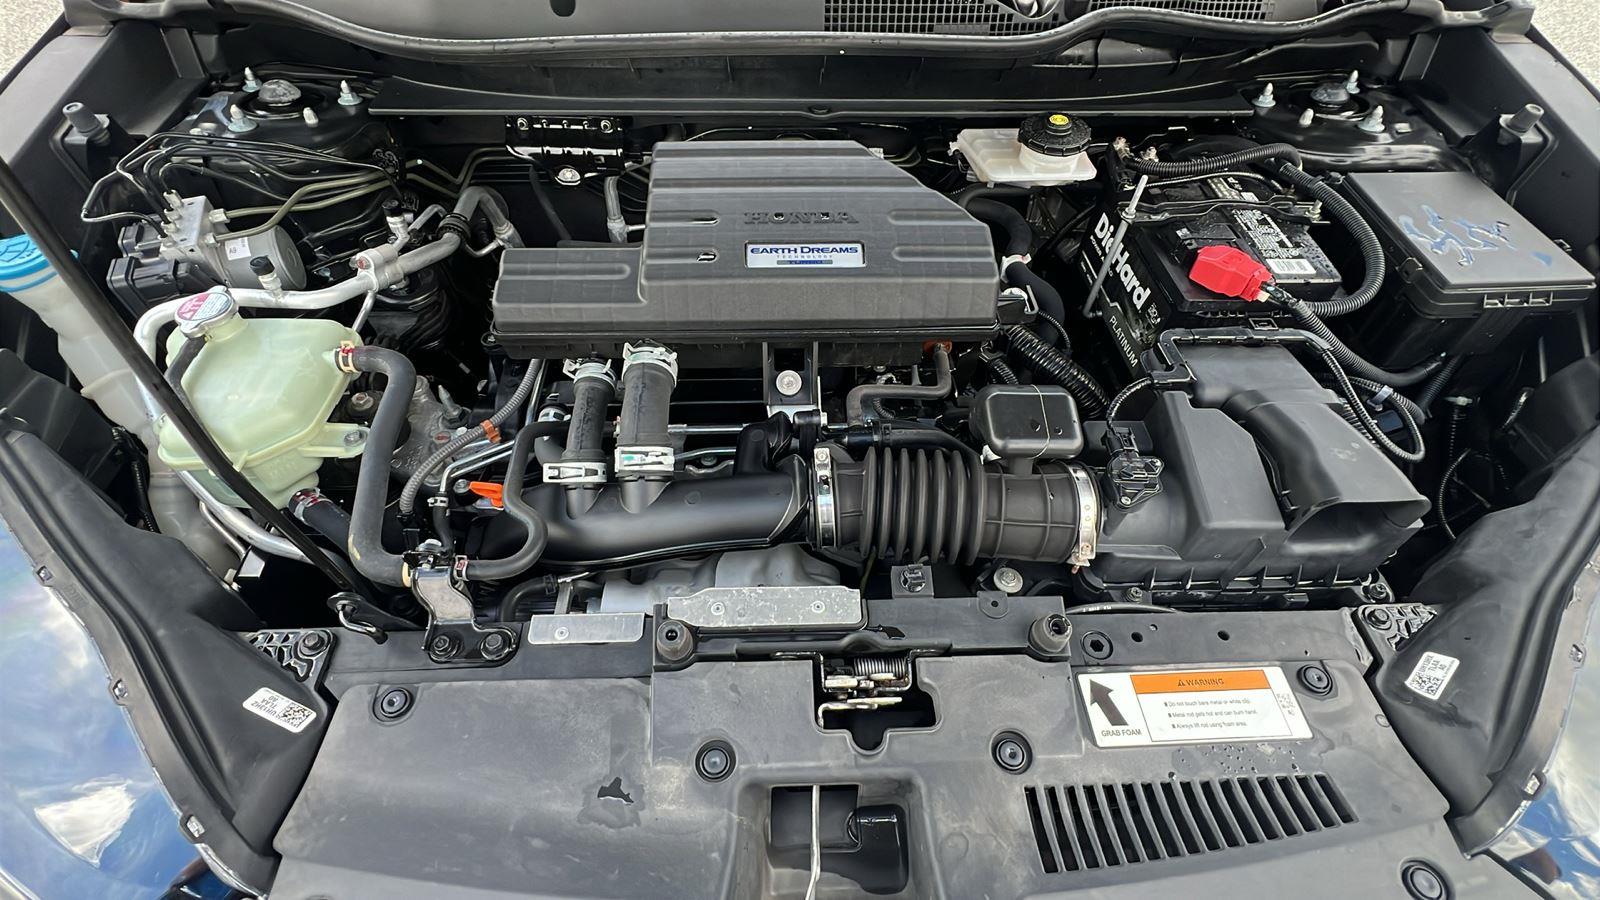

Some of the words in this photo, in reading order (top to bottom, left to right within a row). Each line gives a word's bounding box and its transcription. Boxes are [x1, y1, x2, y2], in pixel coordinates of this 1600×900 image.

[743, 211, 859, 225] HONDA
[800, 246, 858, 254] DREAMS
[1109, 315, 1139, 368] PLATINUM
[1186, 678, 1225, 687] WARNING
[1101, 729, 1121, 737] GRAB
[1121, 729, 1142, 737] FOAM
